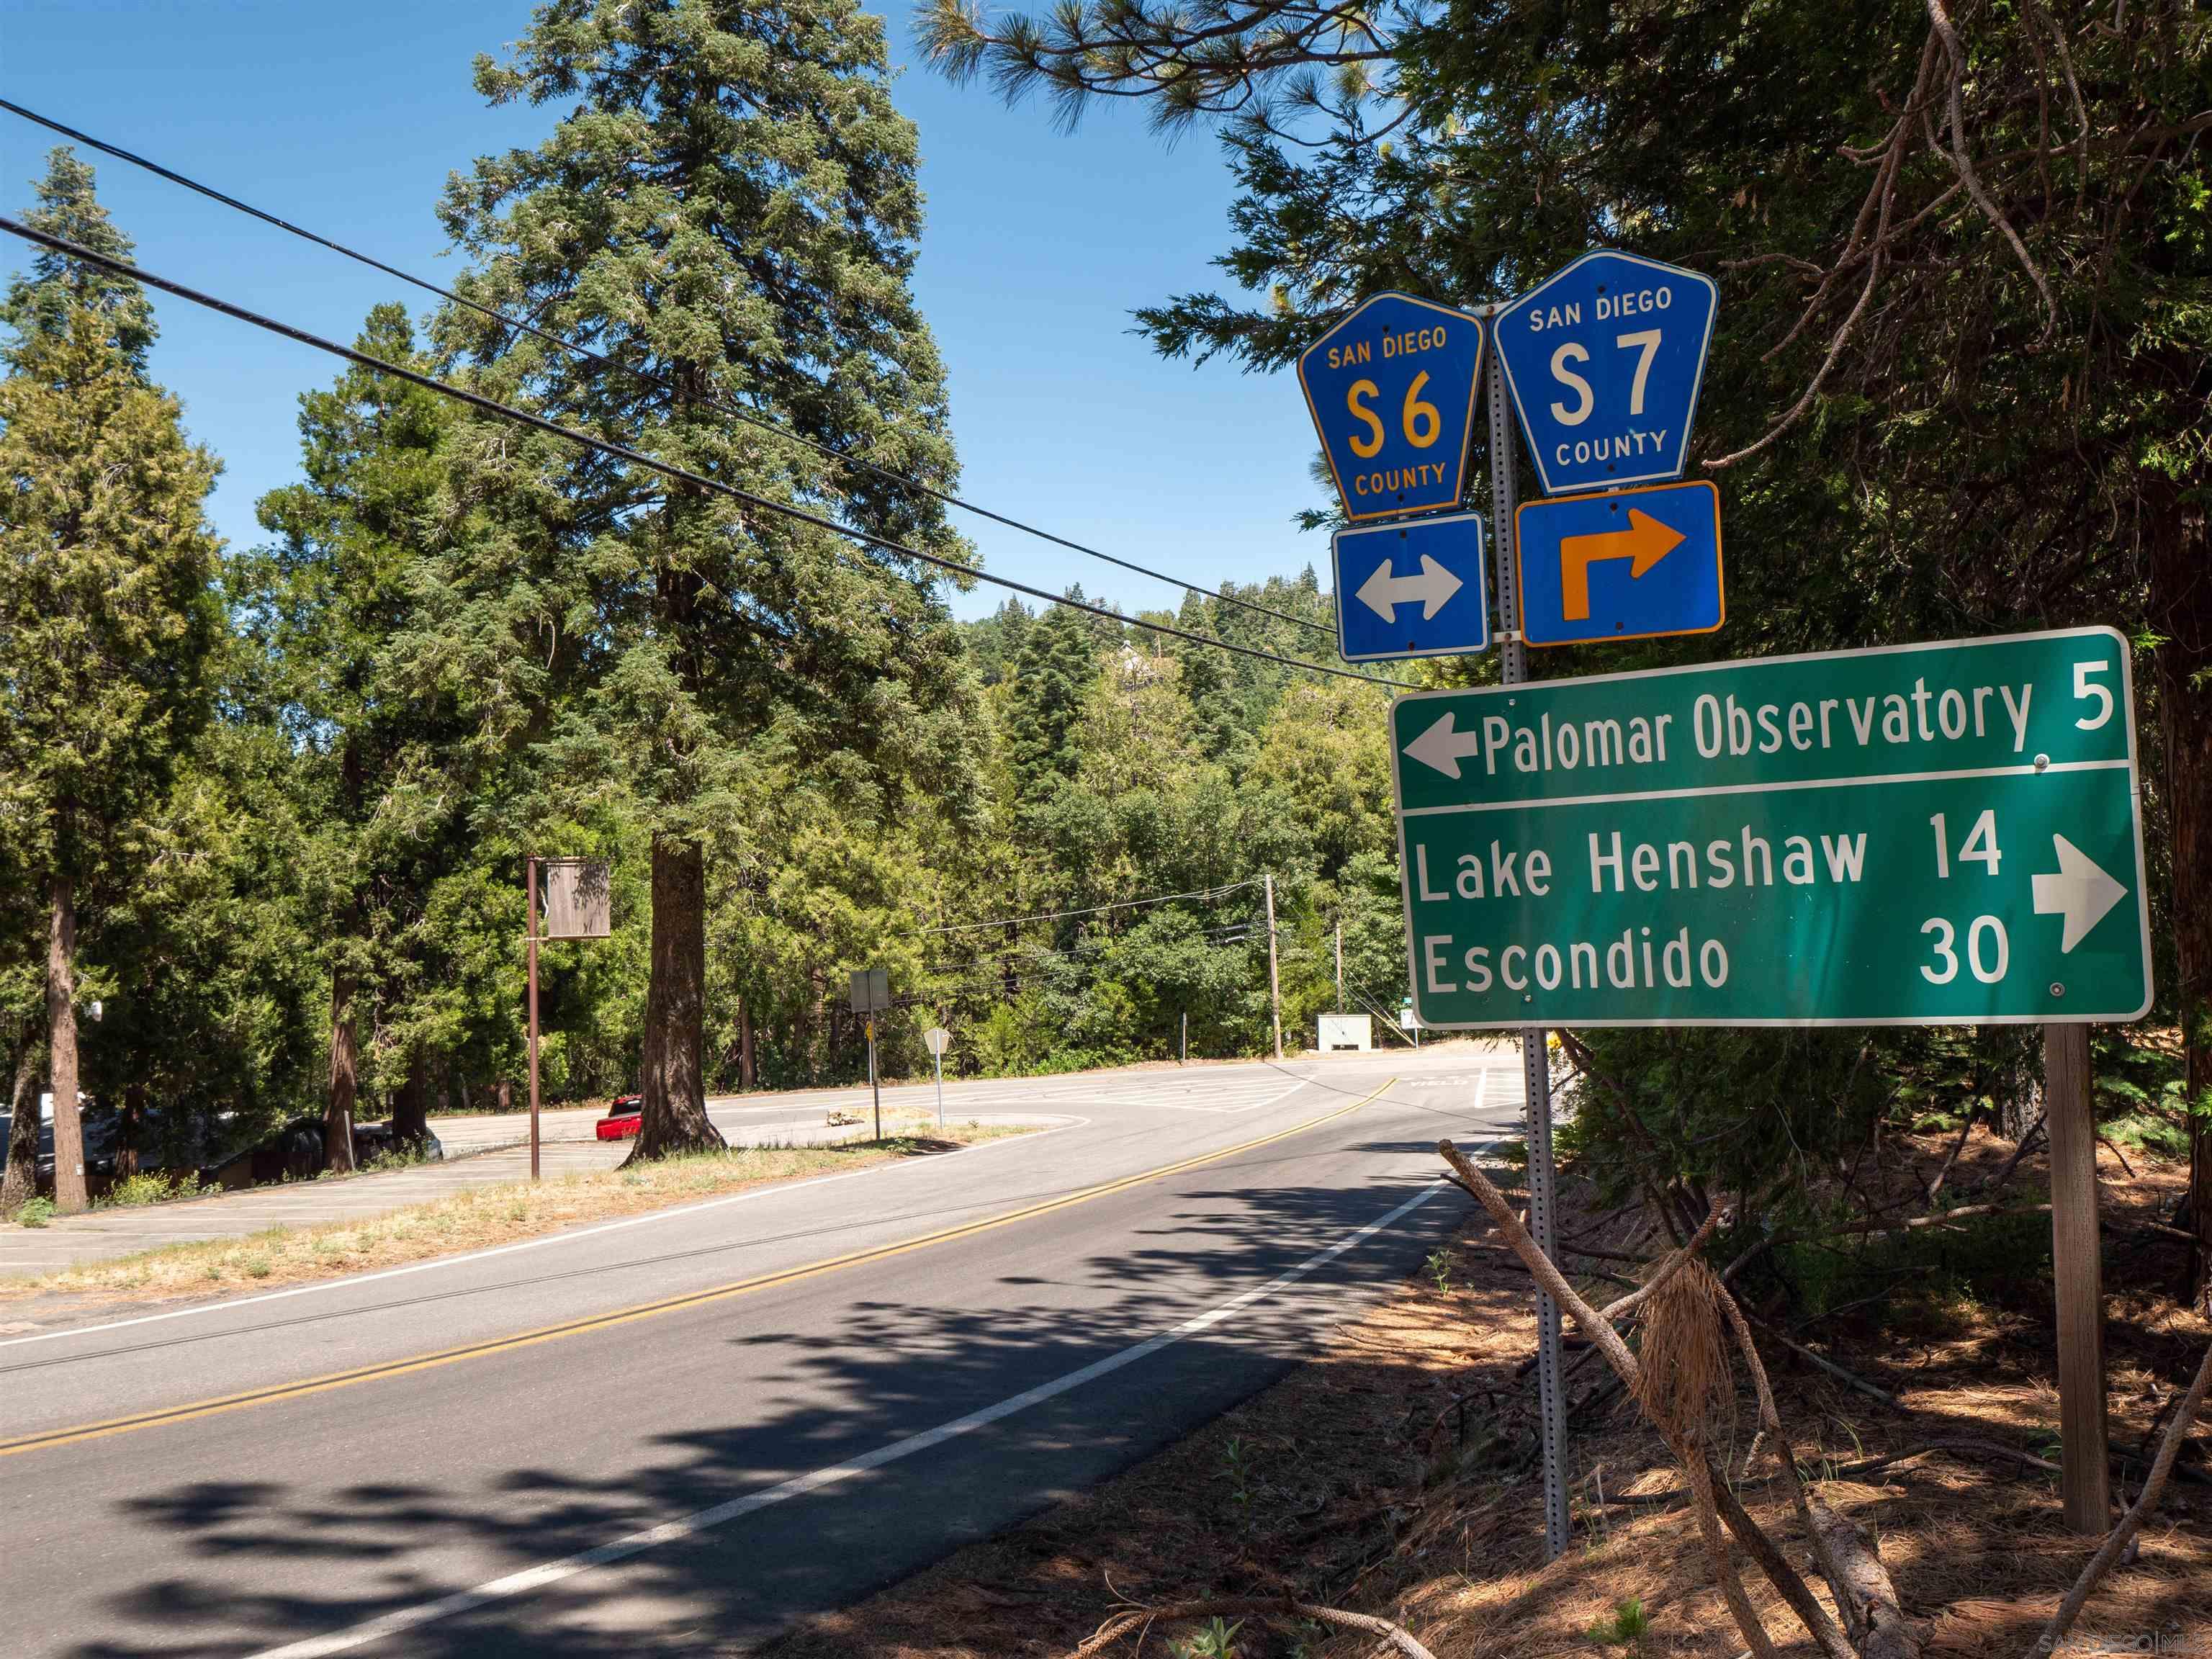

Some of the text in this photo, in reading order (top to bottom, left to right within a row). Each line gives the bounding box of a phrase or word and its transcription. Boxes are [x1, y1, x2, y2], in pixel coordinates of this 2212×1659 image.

[1328, 325, 1447, 369] SAN DIEGO
[1529, 287, 1672, 331] SAN DIEGO
[1346, 370, 1441, 459] S 6
[1550, 328, 1662, 426] S 7
[1354, 463, 1446, 496] COUNTY
[1555, 430, 1667, 466] COUNTY
[1483, 660, 2114, 775] Palomar Observatory 5
[1416, 809, 2002, 901] Lake Henshaw 14
[1424, 914, 2010, 993] Escondido 30
